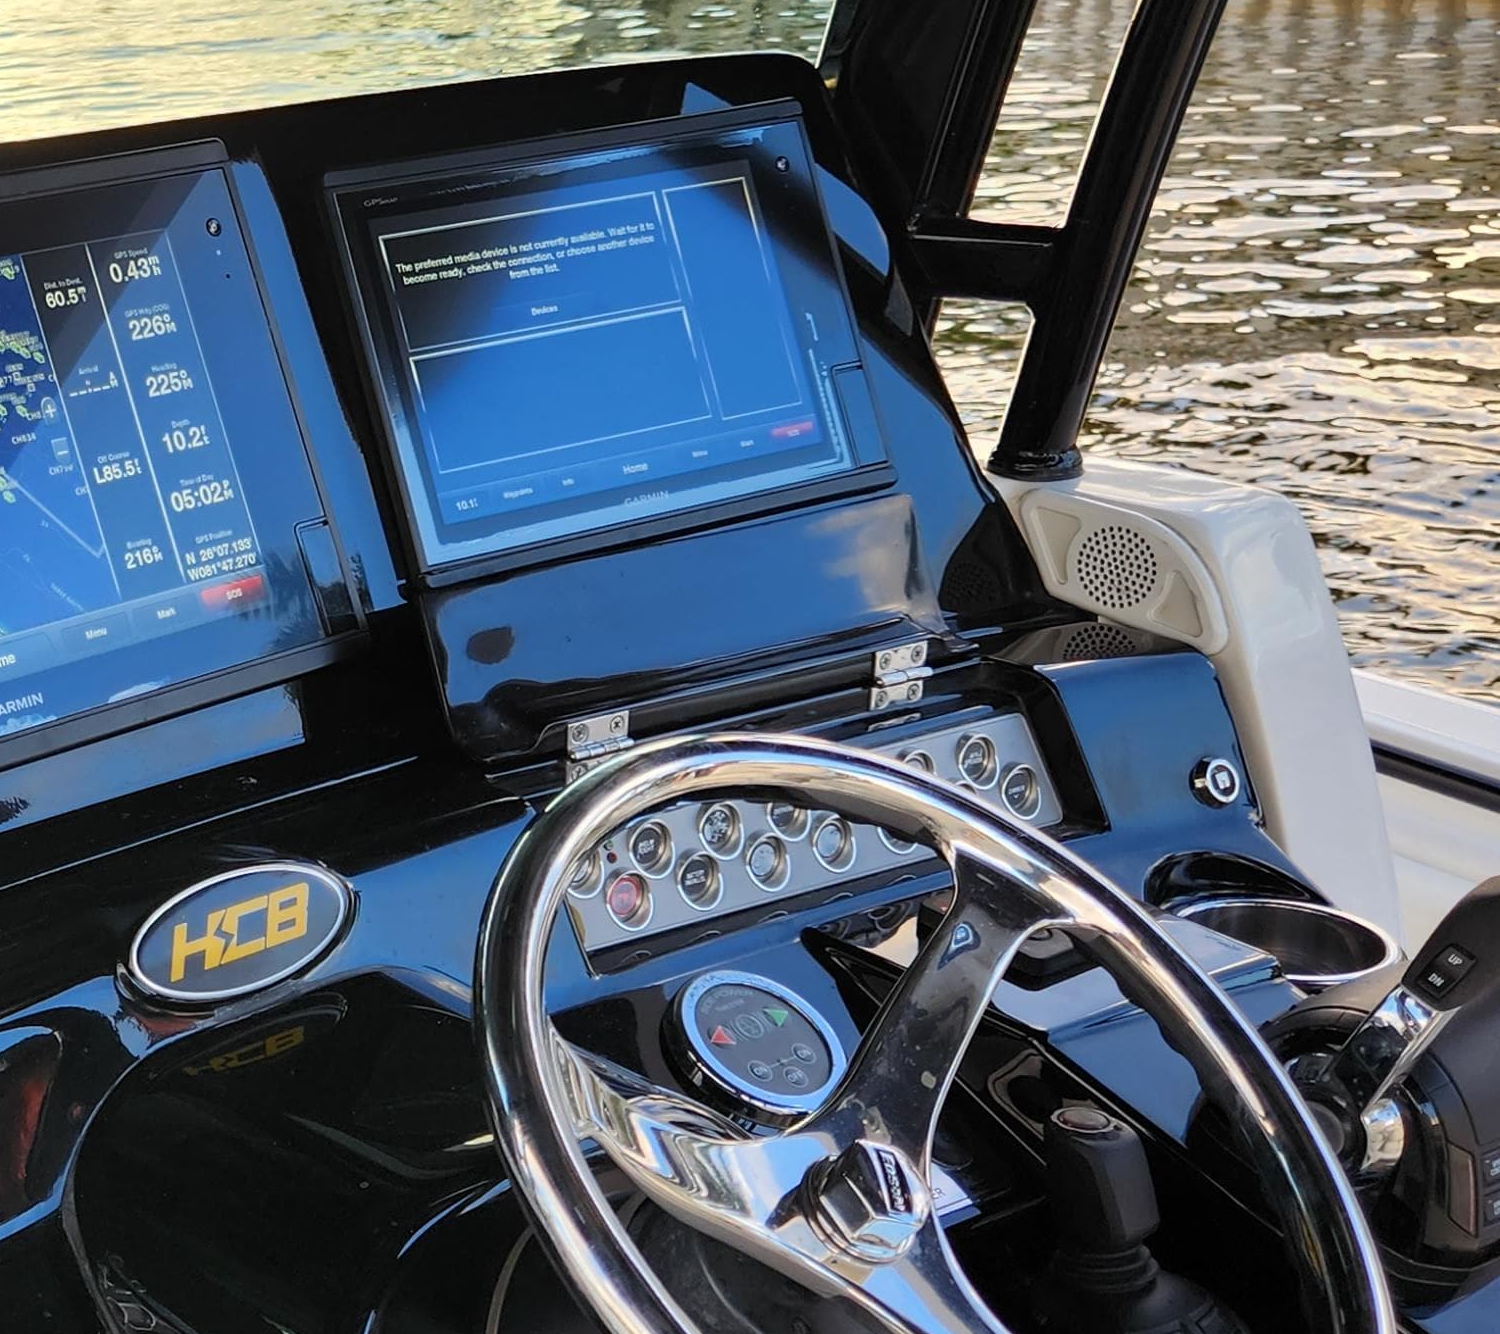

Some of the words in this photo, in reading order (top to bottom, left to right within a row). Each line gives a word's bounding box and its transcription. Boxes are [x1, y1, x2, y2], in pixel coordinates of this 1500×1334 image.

[395, 263, 413, 275] The
[414, 255, 454, 273] preferred
[454, 251, 481, 264] media
[481, 246, 509, 259] device
[510, 245, 518, 255] is
[519, 242, 533, 253] not
[533, 236, 569, 250] currently
[627, 224, 638, 235] for
[402, 271, 438, 286] become
[439, 266, 467, 280] ready,
[467, 260, 493, 275] check
[492, 259, 507, 270] the
[556, 250, 566, 259] or
[566, 245, 597, 259] choose
[597, 239, 628, 253] another
[628, 234, 655, 246] device
[109, 257, 149, 284] 0.43
[509, 268, 529, 280] from
[529, 266, 544, 277] the
[45, 288, 80, 309] 60.5
[162, 427, 204, 454] 10.2
[622, 462, 649, 475] Home
[170, 482, 225, 513] 05:02
[624, 490, 669, 507] GARMIN
[185, 551, 196, 565] N
[85, 626, 108, 641] Menu
[226, 587, 243, 601] SOS
[169, 881, 310, 984] HCB
[1447, 953, 1463, 966] UP
[1427, 972, 1445, 987] DN
[879, 1150, 906, 1212] EDSON
